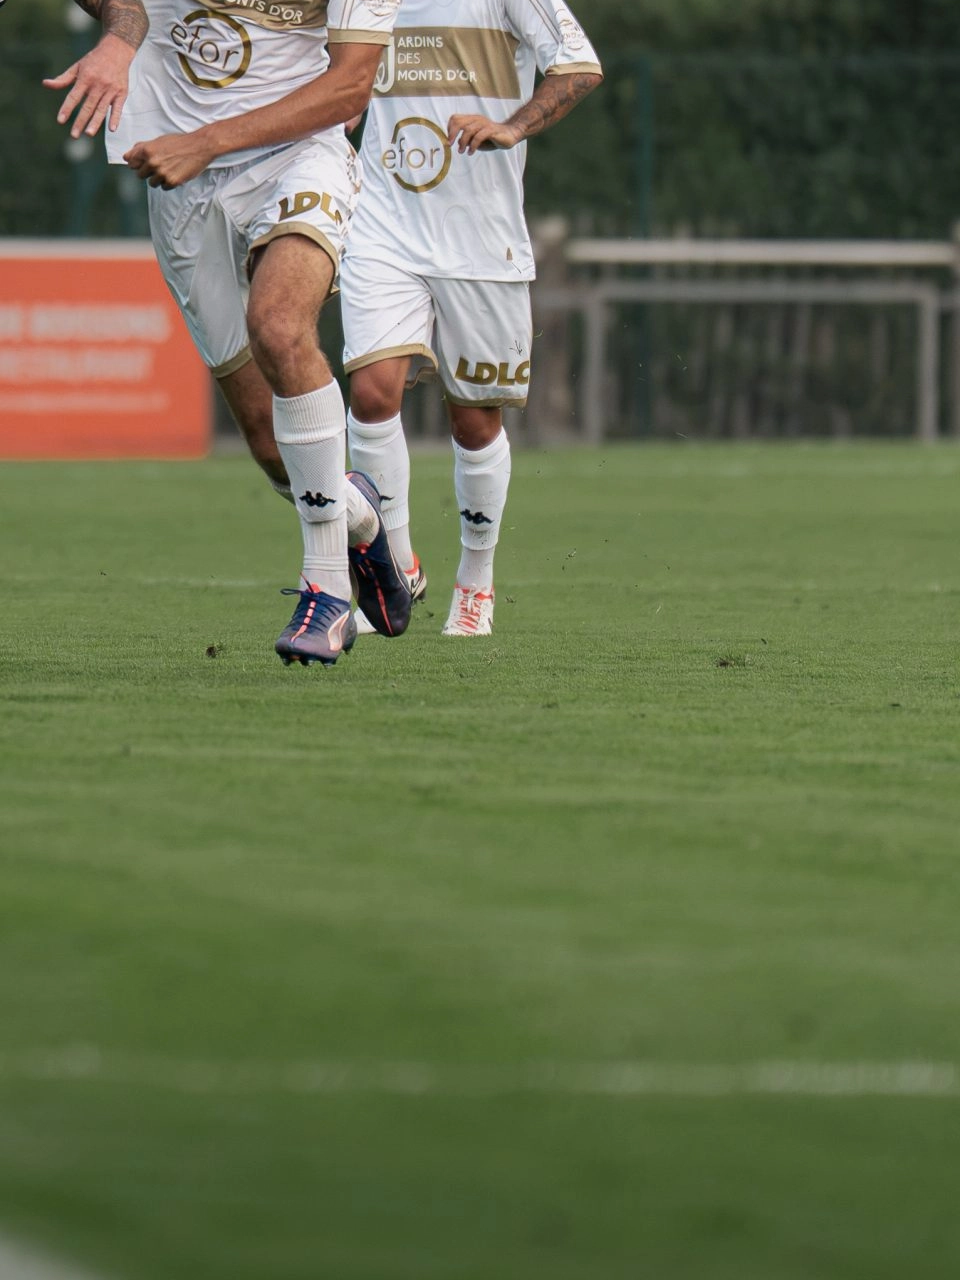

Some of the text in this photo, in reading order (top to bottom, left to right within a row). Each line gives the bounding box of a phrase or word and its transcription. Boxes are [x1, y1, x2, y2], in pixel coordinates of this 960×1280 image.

[269, 5, 303, 25] D'OR
[171, 23, 239, 70] efor
[397, 52, 421, 65] DES
[397, 69, 478, 83] MONTS D'OR
[382, 137, 440, 170] efor
[454, 356, 530, 386] LDLC
